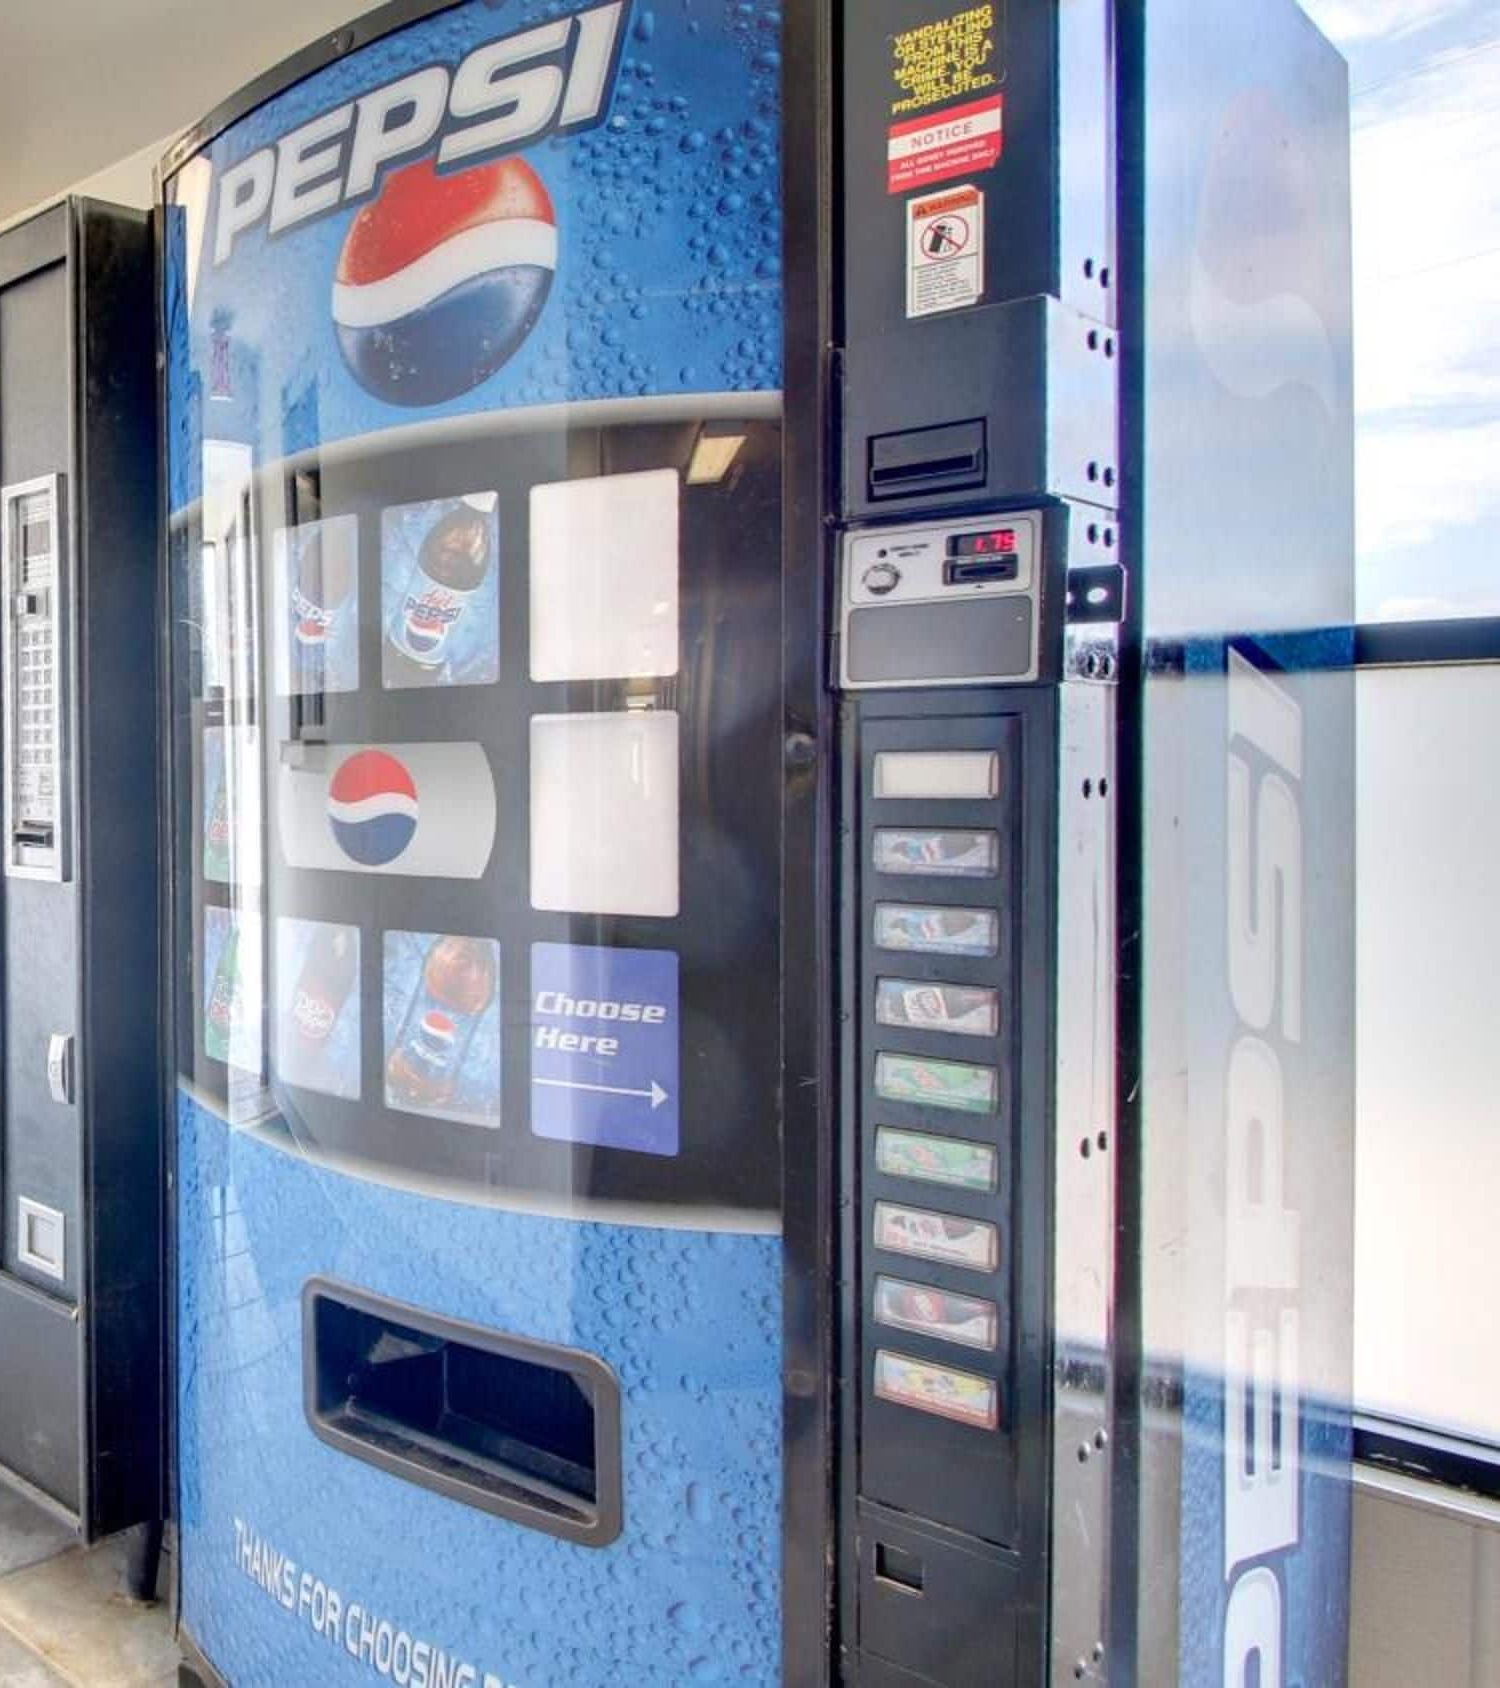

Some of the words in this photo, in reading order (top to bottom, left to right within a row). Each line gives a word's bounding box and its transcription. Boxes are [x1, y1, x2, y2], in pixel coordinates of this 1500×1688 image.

[894, 5, 991, 47] VANDALIZING
[894, 43, 914, 58] OR
[916, 15, 992, 50] STEALING
[894, 48, 963, 80] MACHINE
[955, 52, 986, 71] YOU
[212, 1, 625, 266] PEPSI
[911, 121, 973, 149] NOTICE
[534, 991, 667, 1024] Choose
[534, 1026, 619, 1056] Here
[233, 1518, 295, 1610] THANKS
[300, 1572, 342, 1644] FOR
